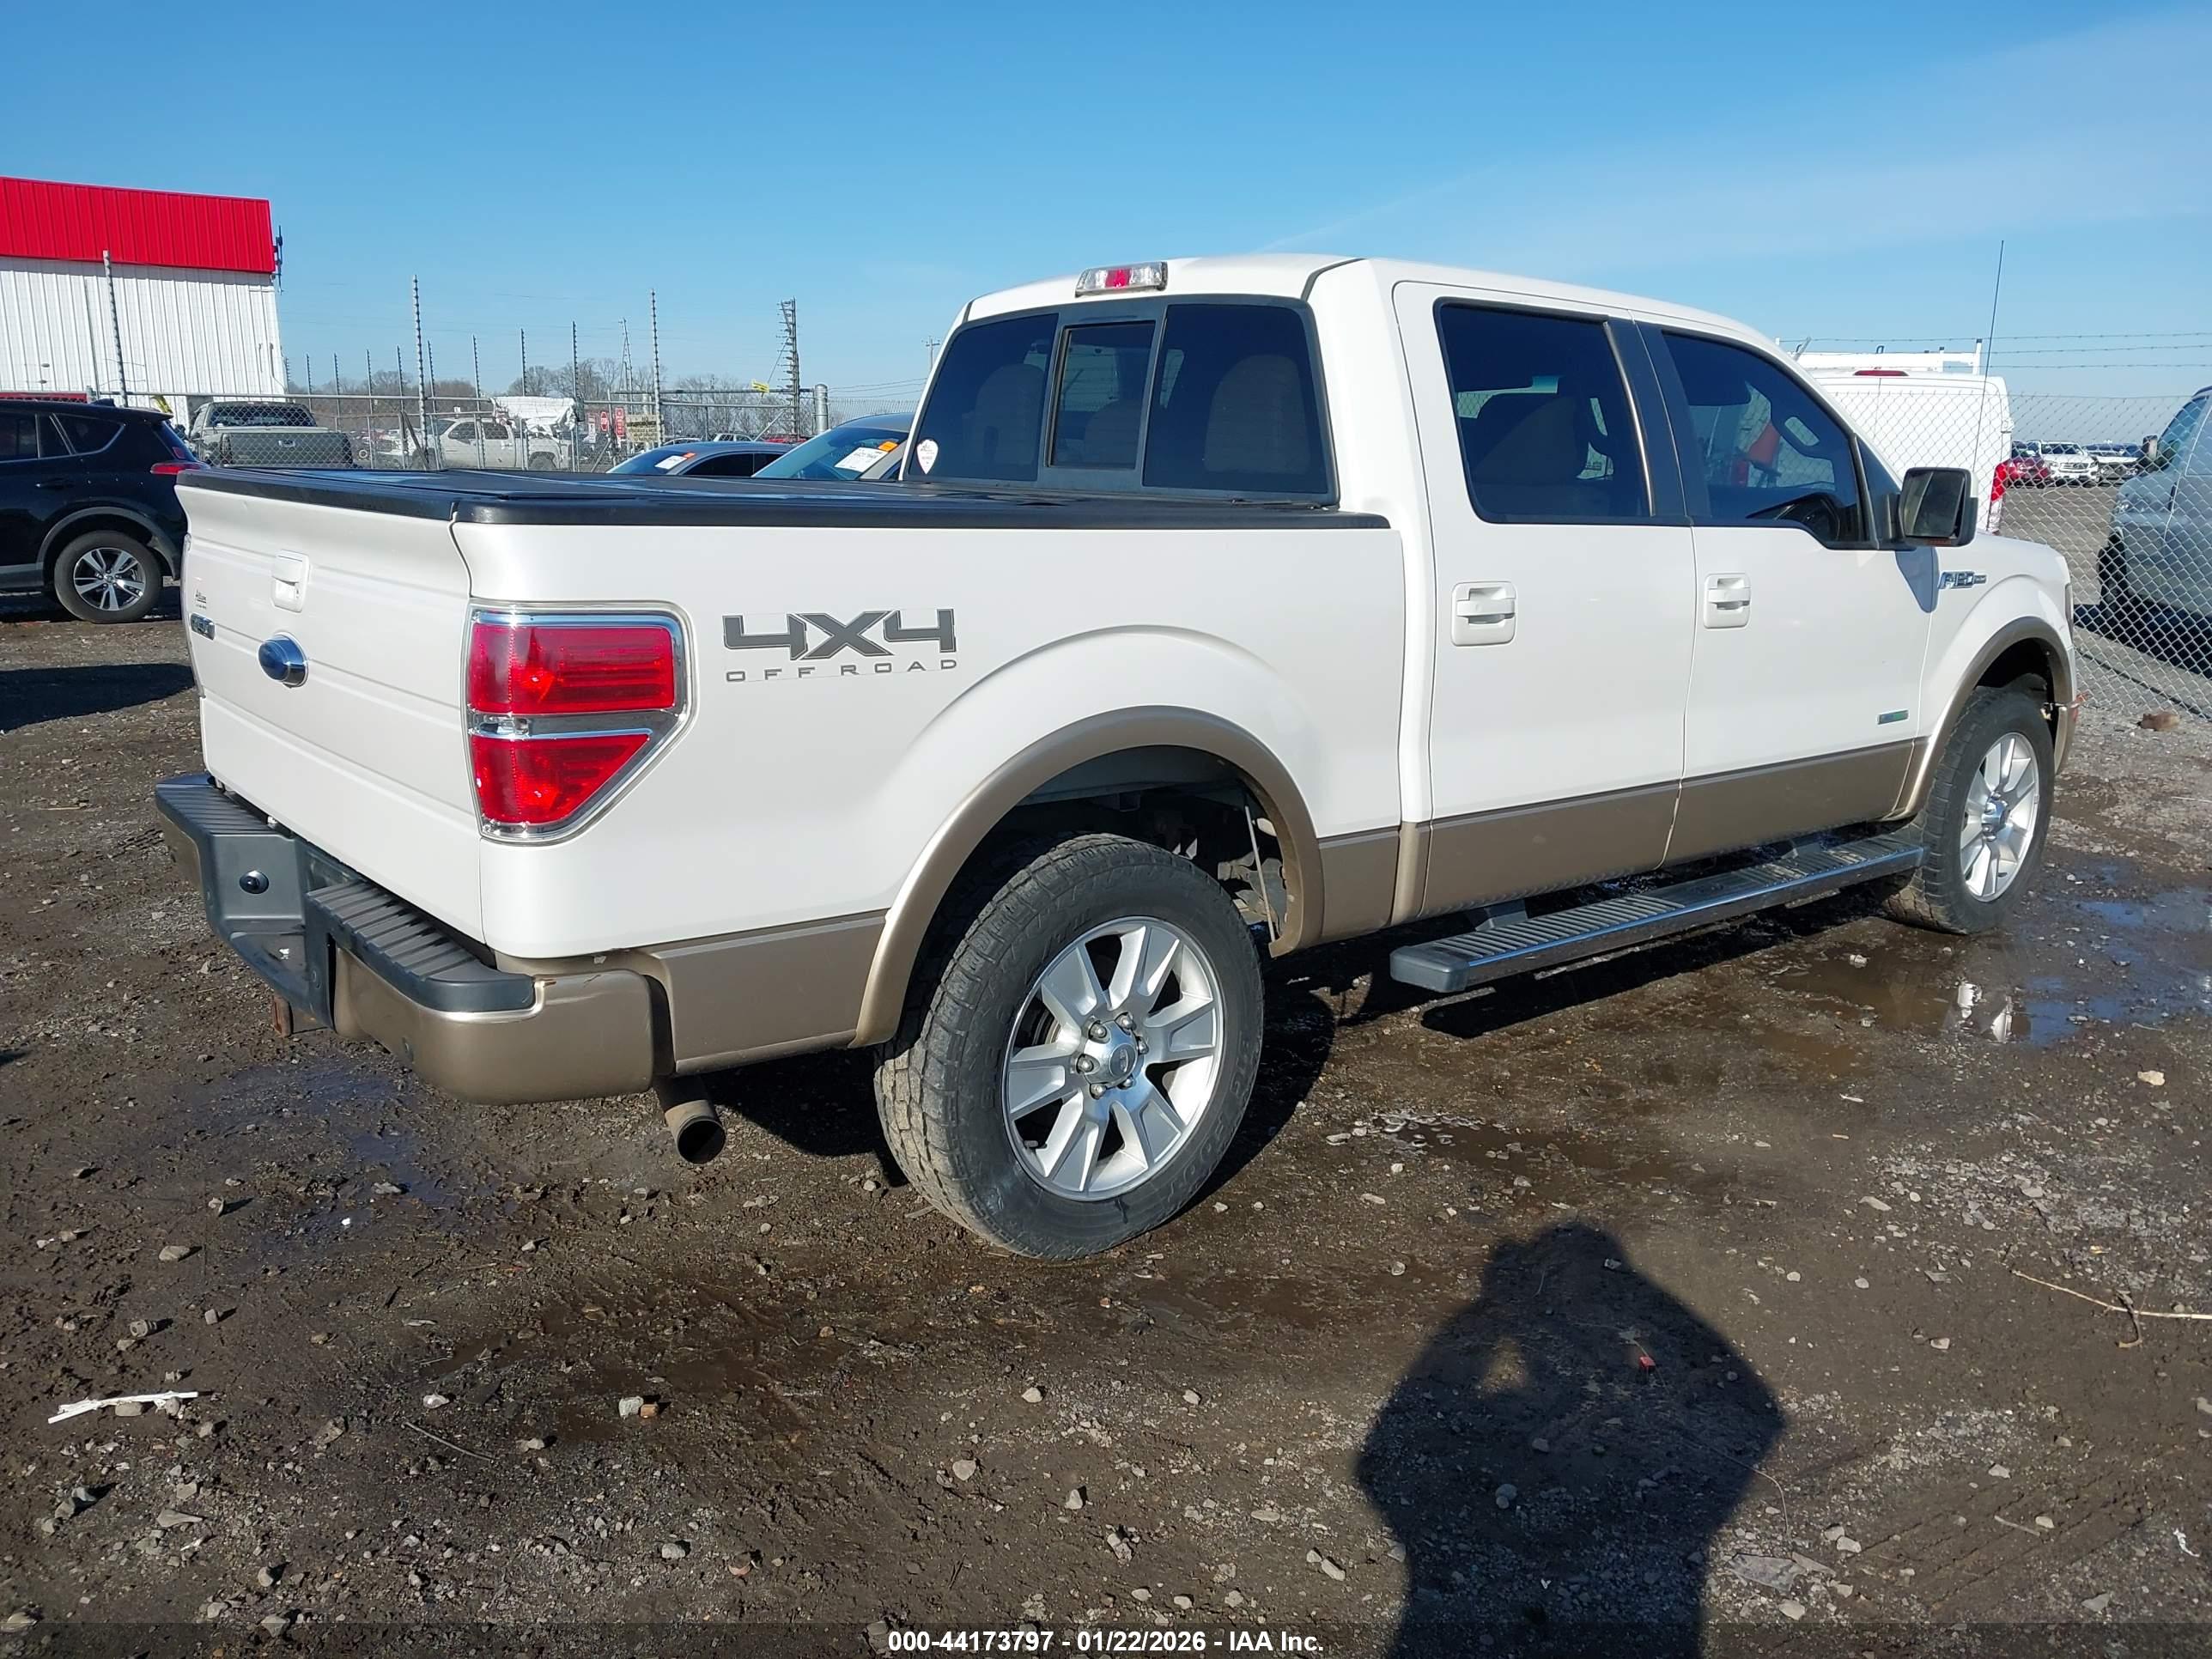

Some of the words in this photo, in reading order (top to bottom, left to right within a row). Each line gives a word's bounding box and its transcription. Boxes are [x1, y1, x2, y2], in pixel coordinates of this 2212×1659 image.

[722, 608, 957, 660] 4X4
[726, 667, 816, 682] OFF
[840, 659, 957, 677] ROAD
